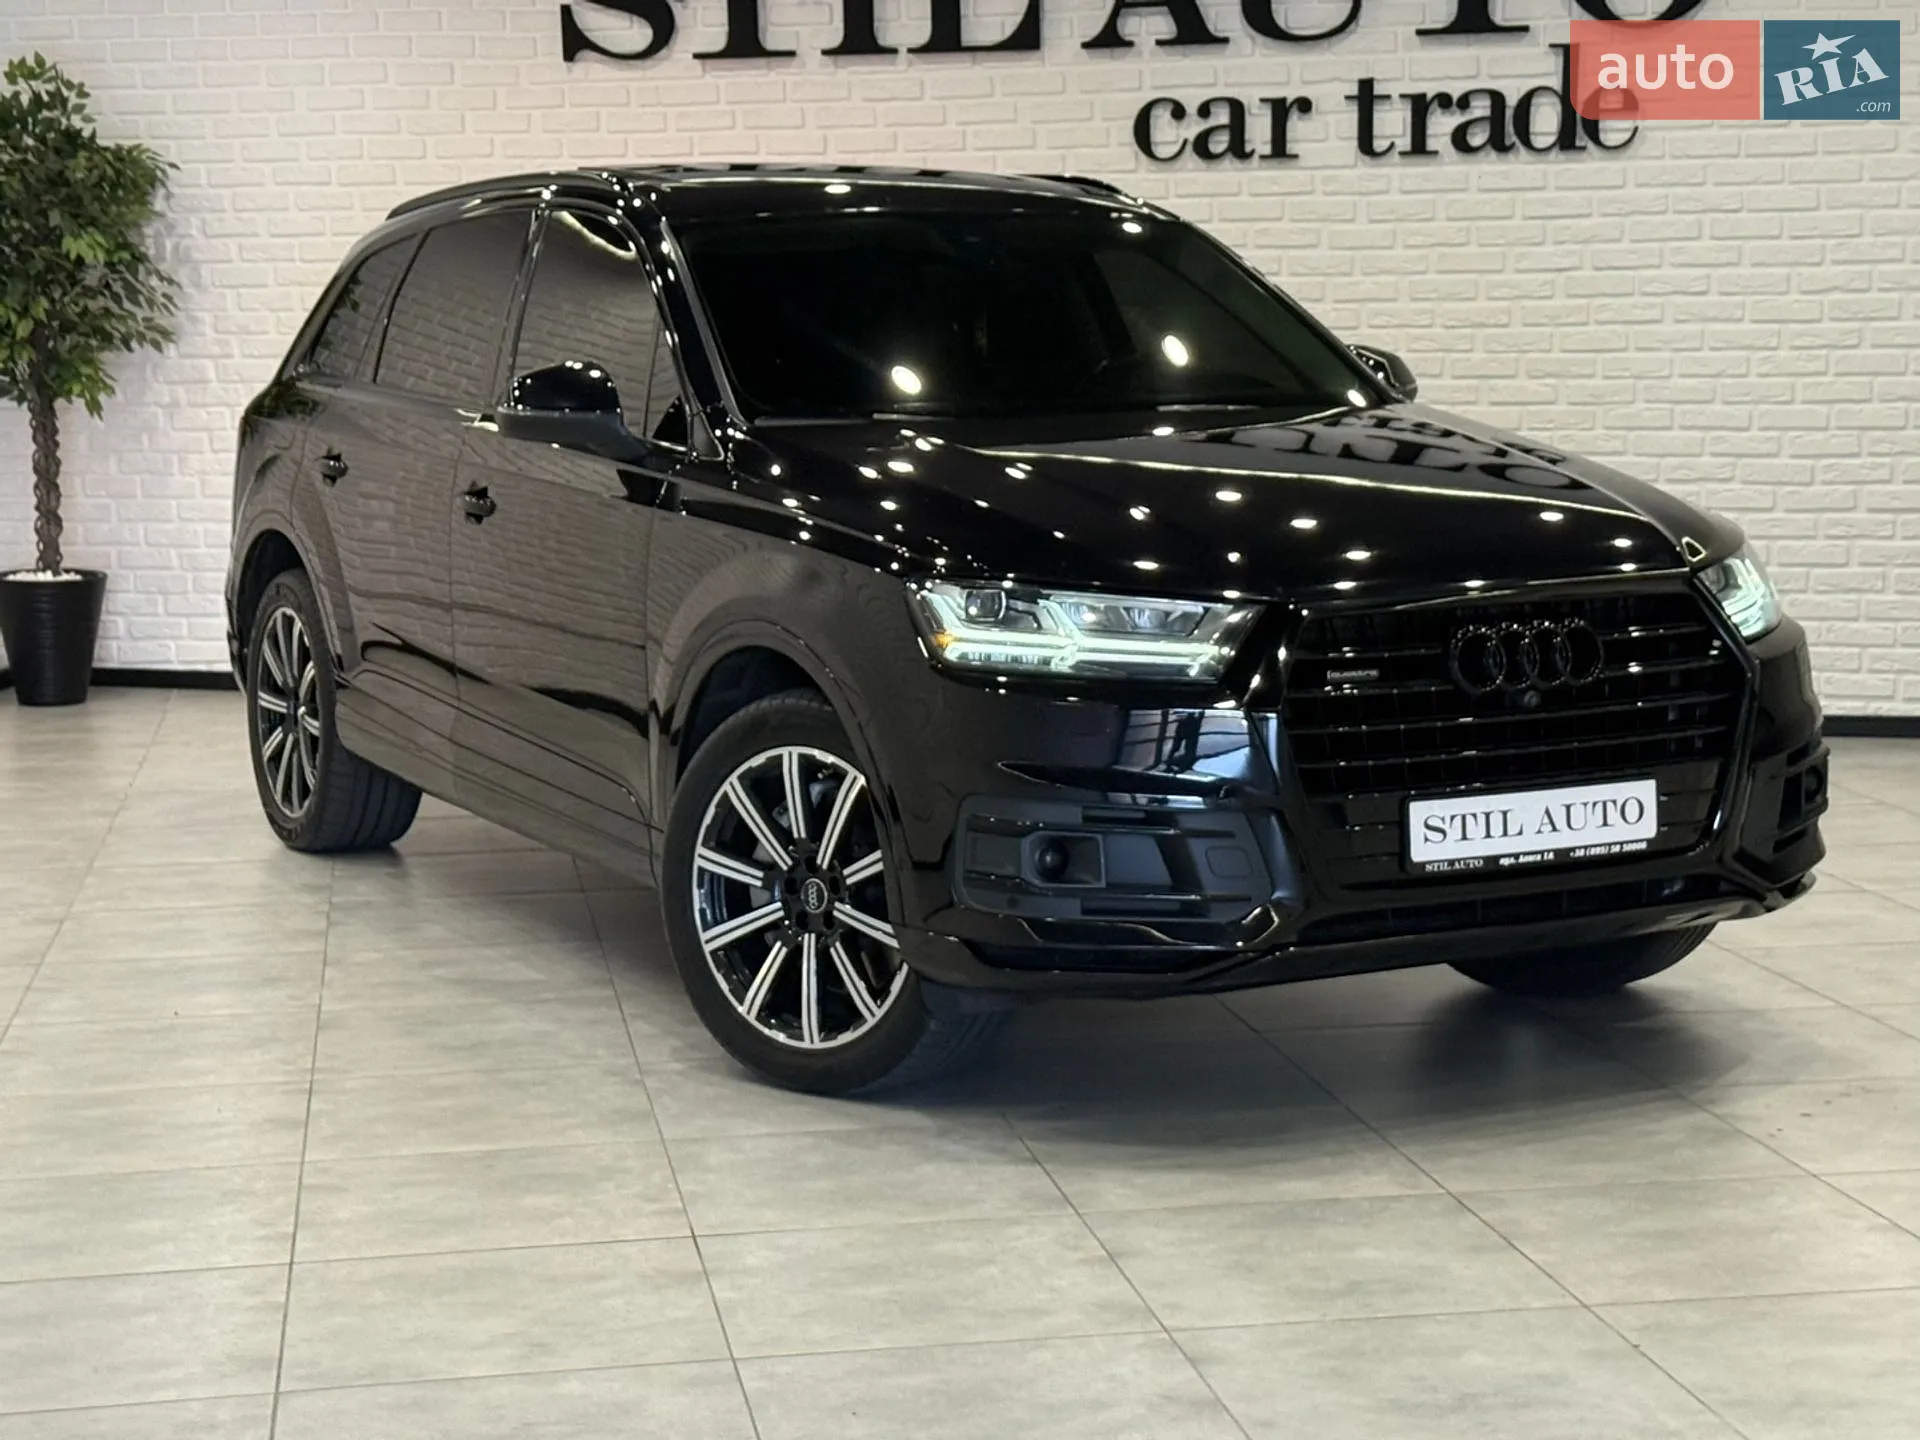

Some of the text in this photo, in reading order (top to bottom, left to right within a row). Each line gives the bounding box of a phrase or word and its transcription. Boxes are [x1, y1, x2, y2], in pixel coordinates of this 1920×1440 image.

[1133, 42, 1640, 163] car trade
[1423, 796, 1645, 844] STIL AUTO
[1425, 859, 1483, 872] STIL AUTO
